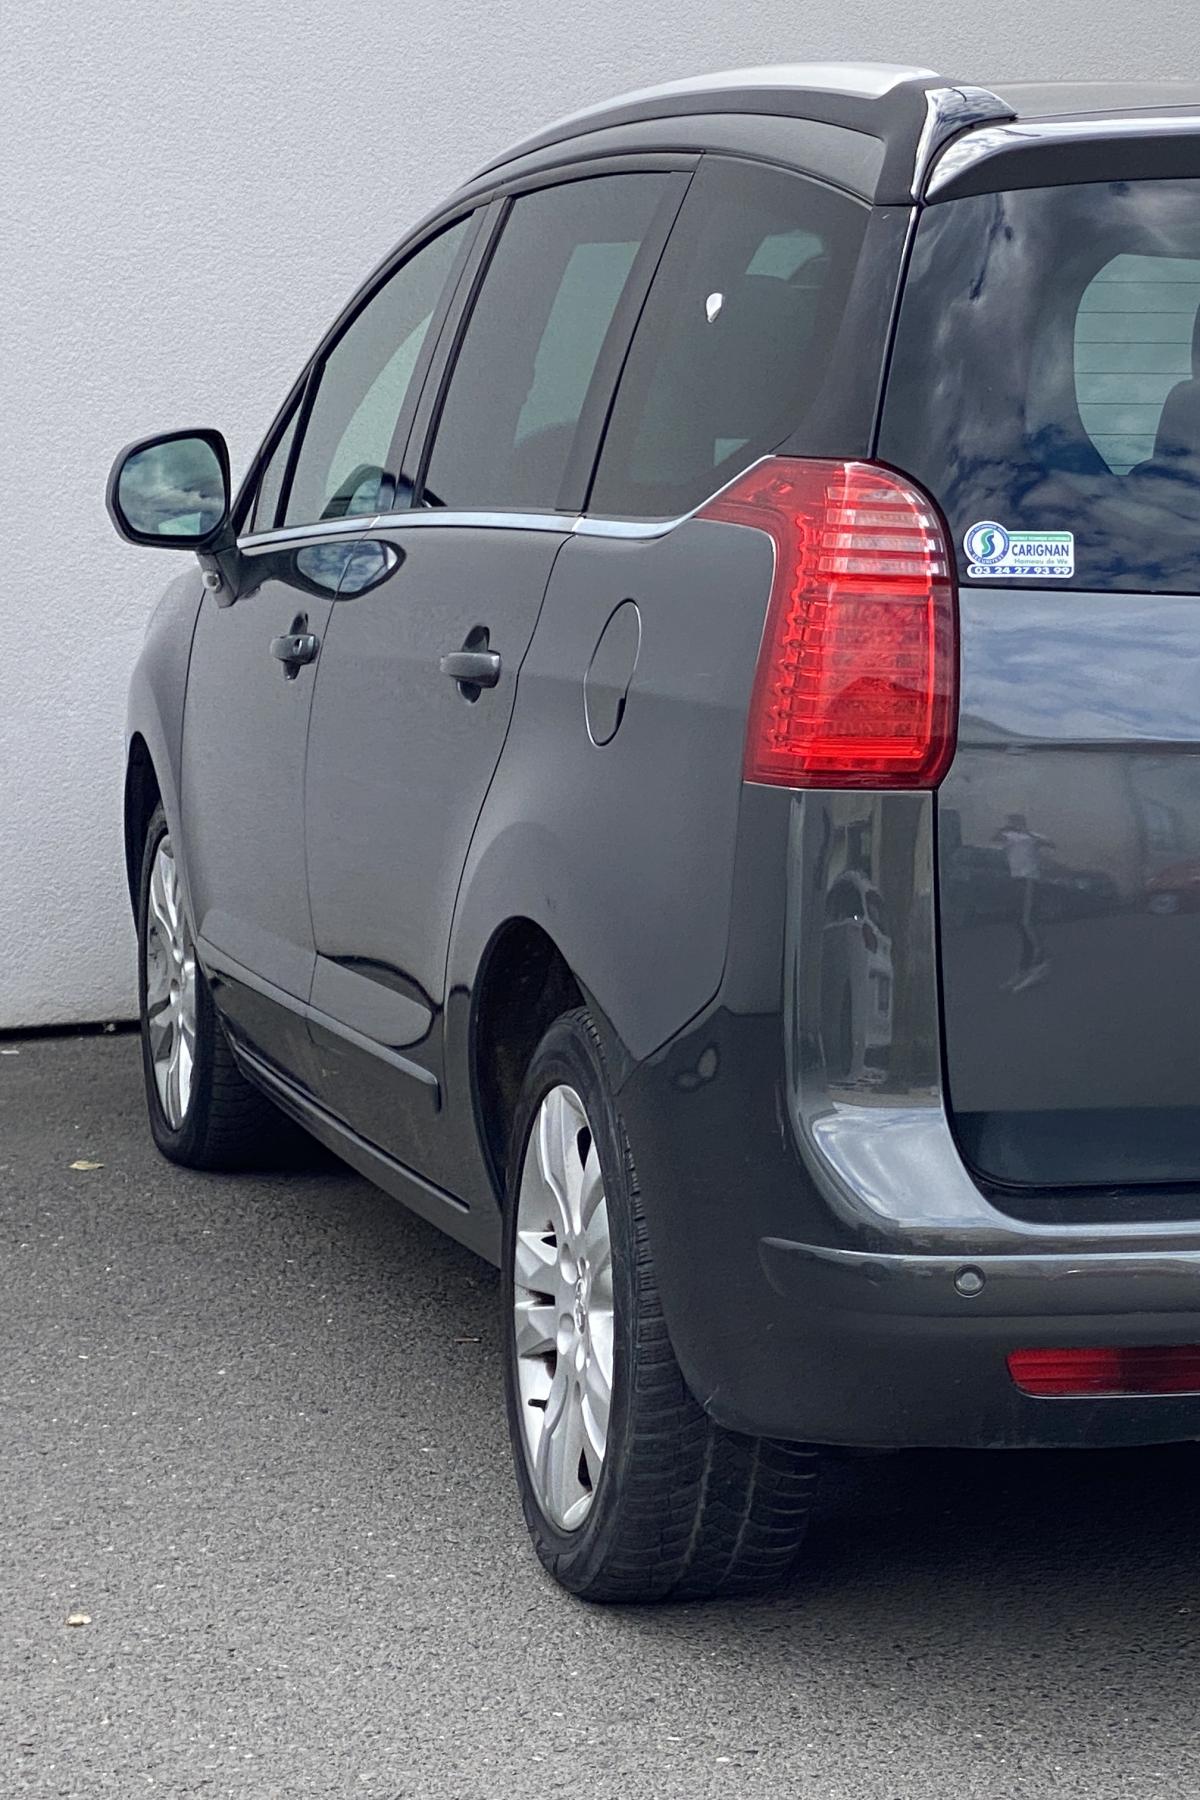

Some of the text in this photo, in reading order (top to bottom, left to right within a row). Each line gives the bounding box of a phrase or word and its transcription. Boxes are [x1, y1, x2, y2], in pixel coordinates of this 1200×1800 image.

[1011, 543, 1069, 557] CARIGNAN
[974, 566, 1070, 575] 03 24 27 93 99
